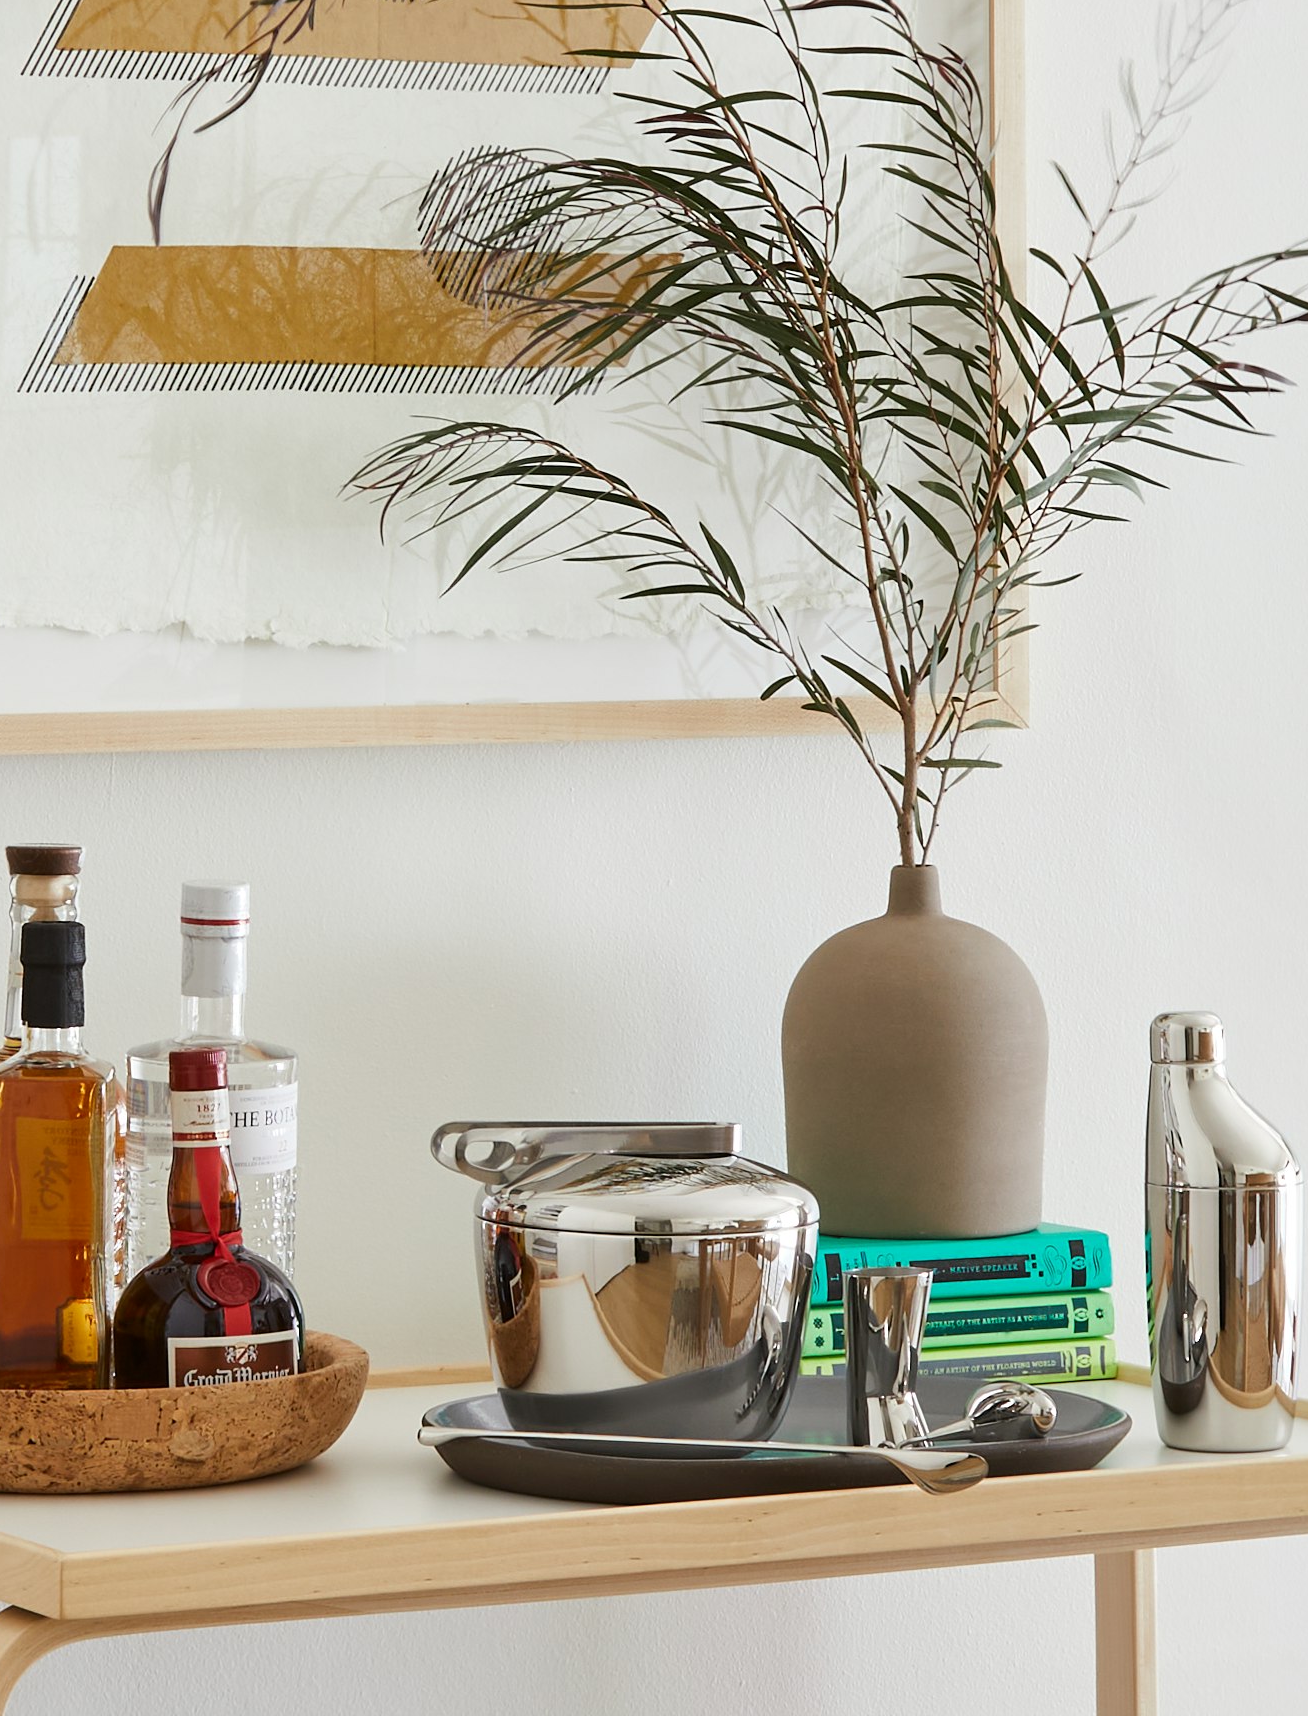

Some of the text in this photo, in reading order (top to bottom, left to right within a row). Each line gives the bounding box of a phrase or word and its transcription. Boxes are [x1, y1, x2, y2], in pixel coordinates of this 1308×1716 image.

[230, 1110, 260, 1128] HE
[949, 1264, 980, 1274] NATIVE
[983, 1263, 1019, 1273] SPEAKER
[957, 1319, 965, 1327] OF
[967, 1318, 980, 1326] THE
[982, 1316, 1006, 1325] ARTIST
[946, 1365, 968, 1374] ARTIST
[971, 1363, 981, 1371] OF
[982, 1363, 995, 1371] THE
[996, 1360, 1030, 1369] FLOATING
[1032, 1359, 1057, 1368] WORLD
